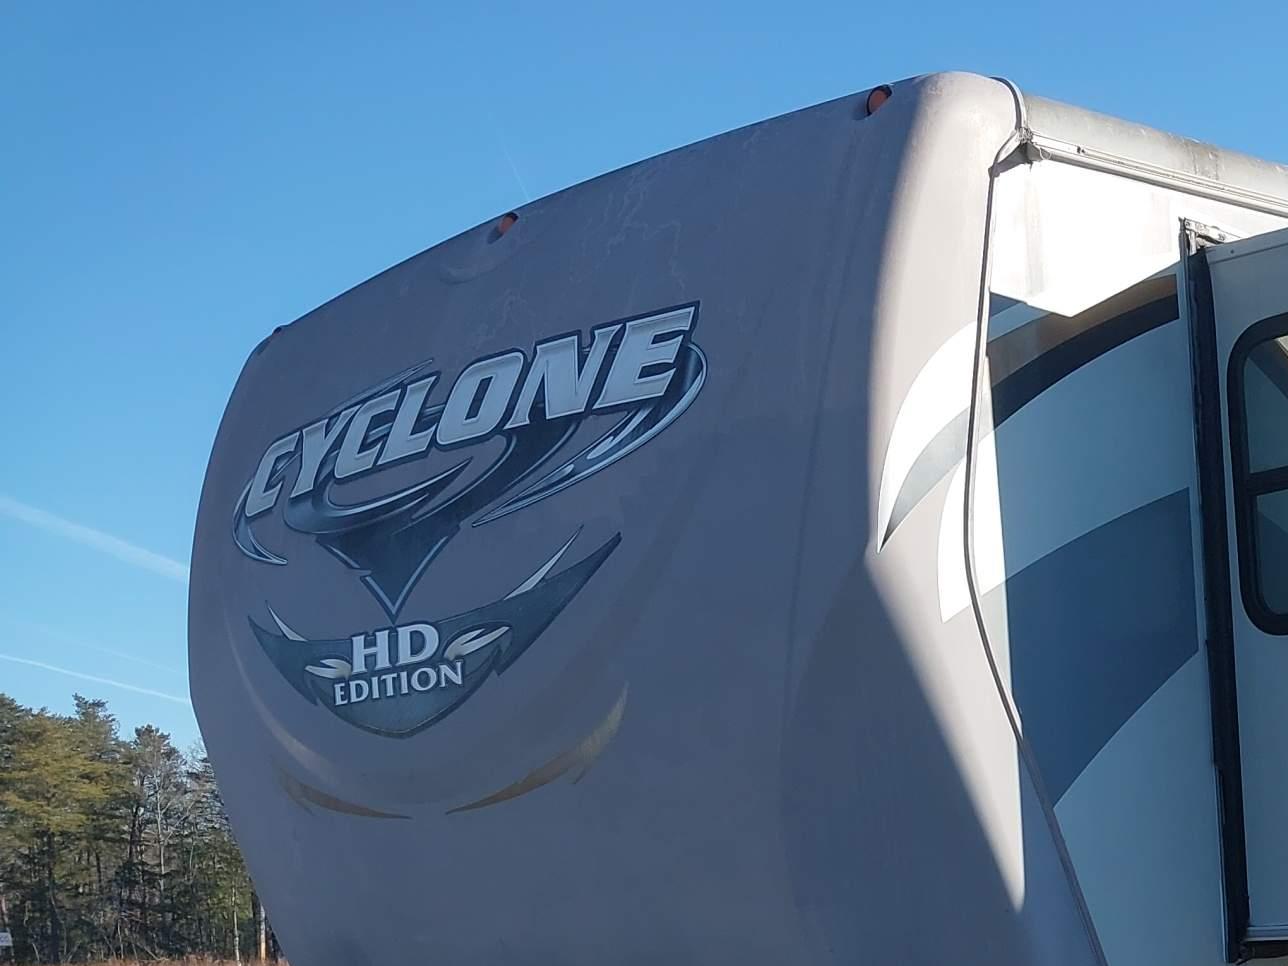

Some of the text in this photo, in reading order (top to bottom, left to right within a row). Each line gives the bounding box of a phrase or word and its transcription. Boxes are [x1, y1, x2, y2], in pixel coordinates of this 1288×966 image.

[244, 304, 698, 518] CYCLONE
[350, 622, 441, 674] HD
[333, 659, 464, 707] EDITION
